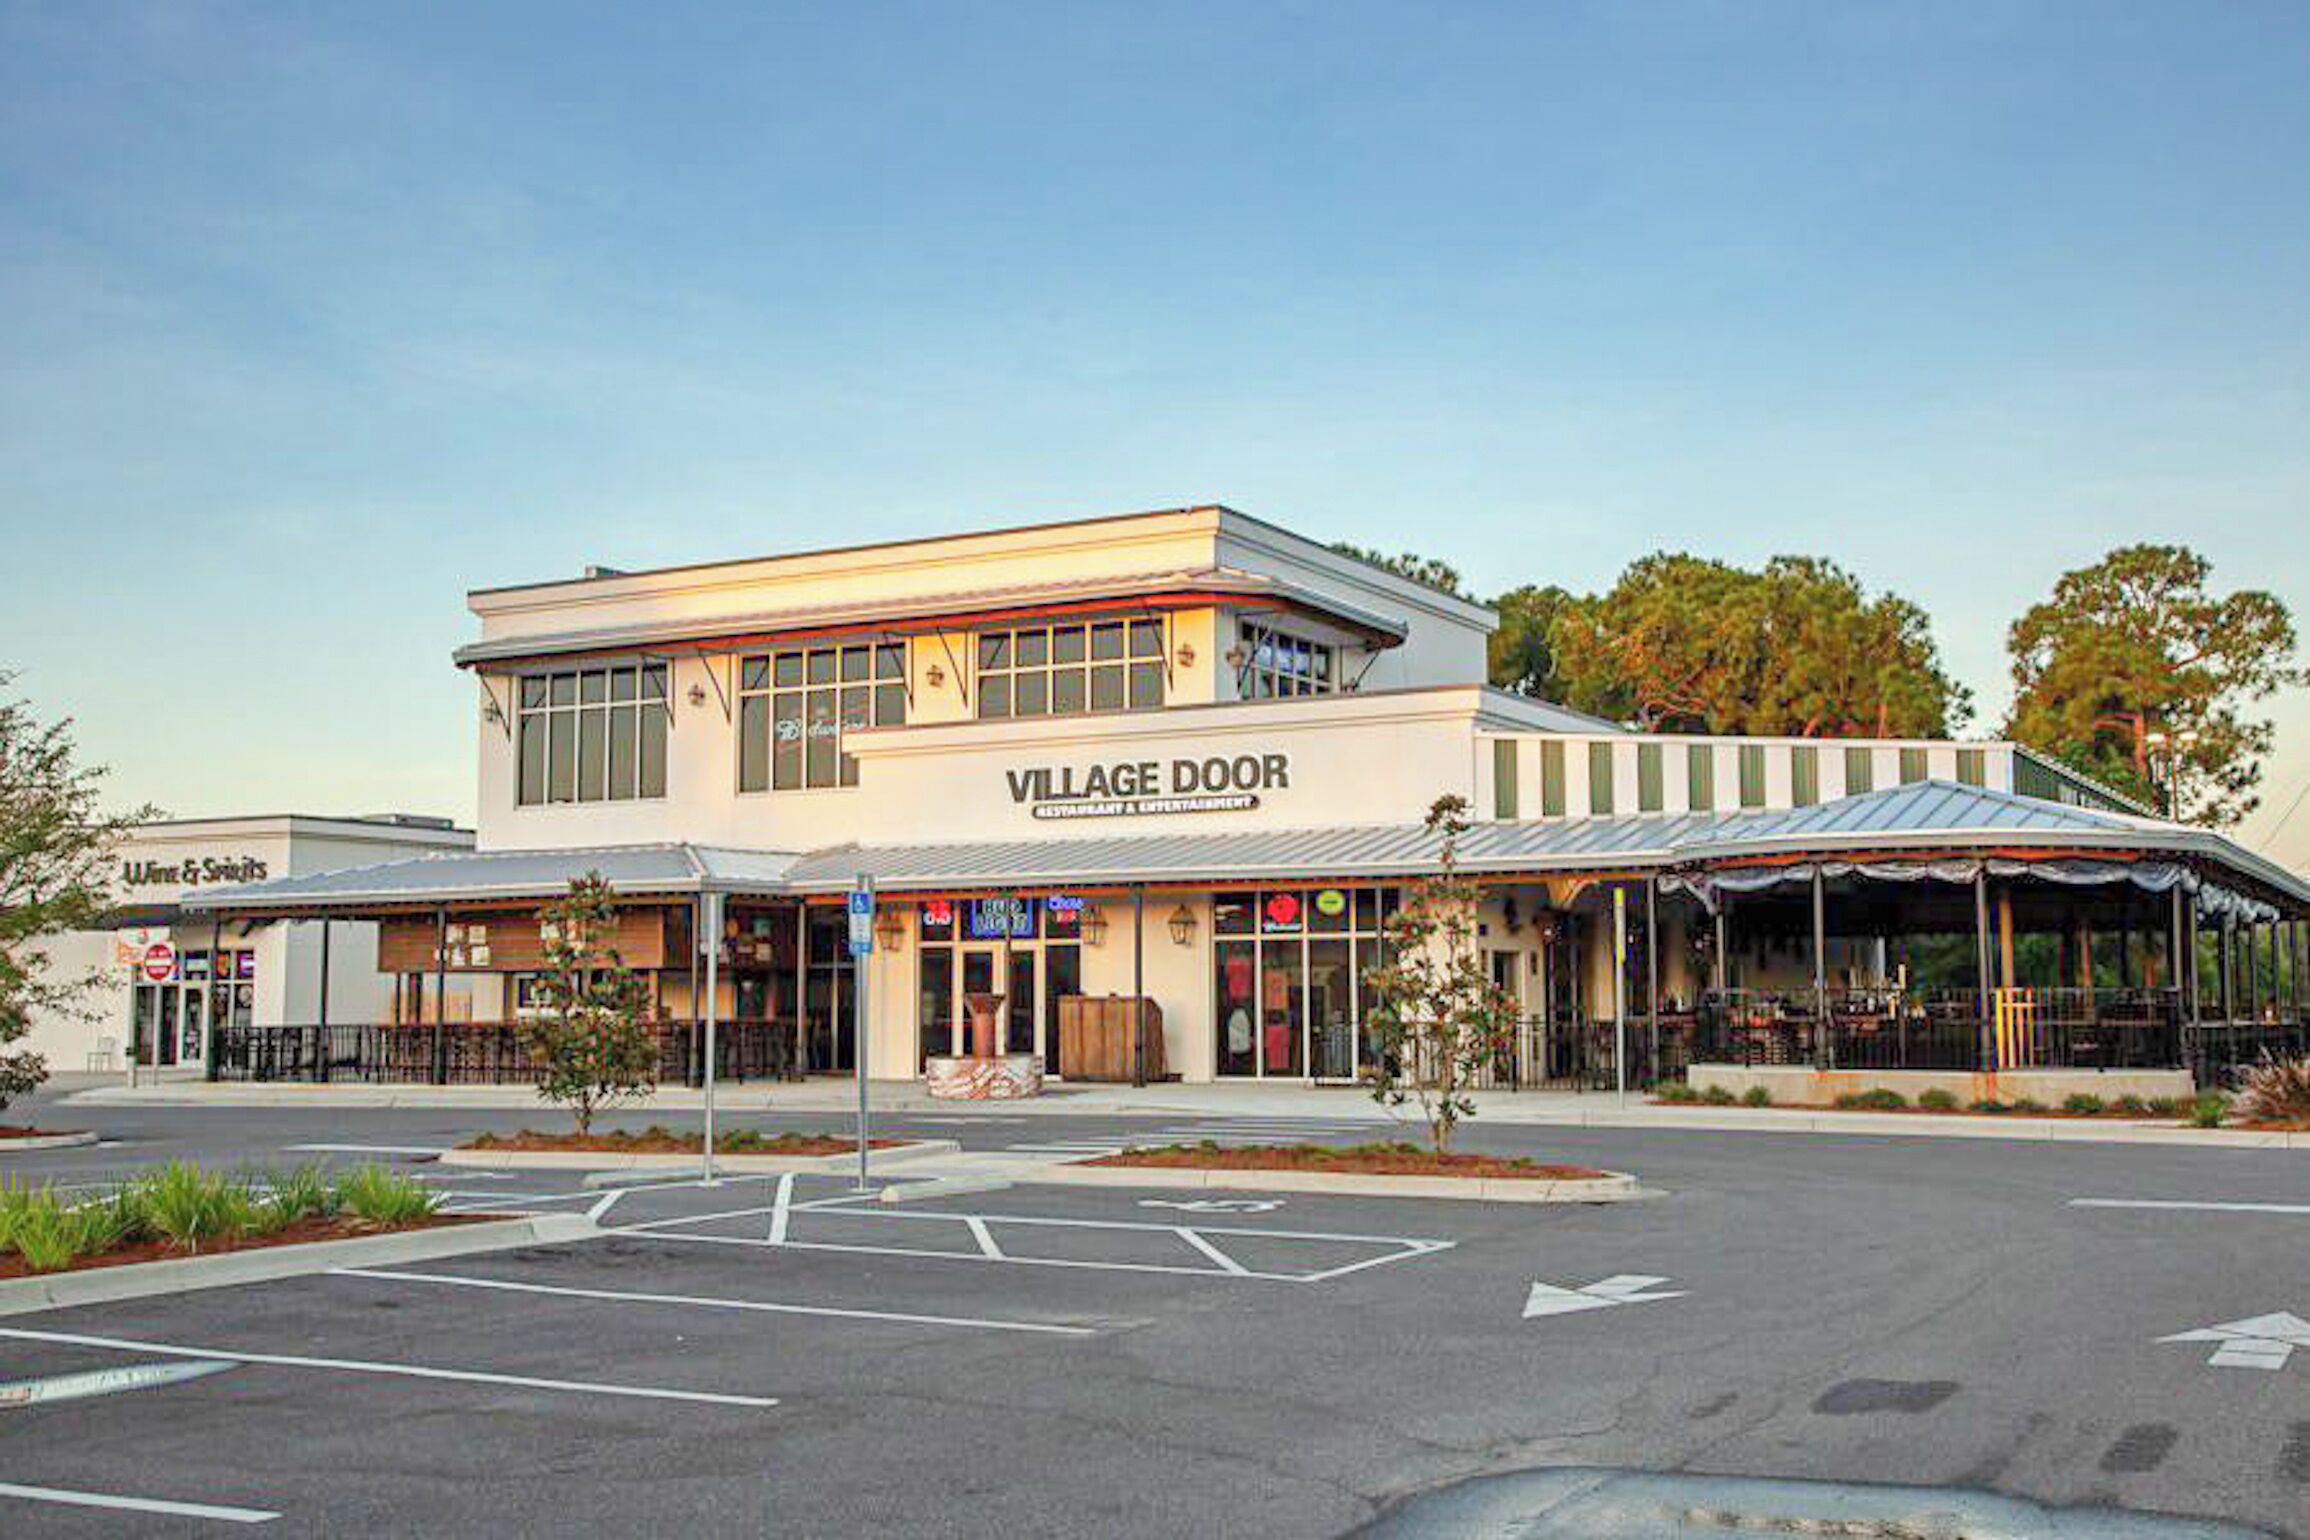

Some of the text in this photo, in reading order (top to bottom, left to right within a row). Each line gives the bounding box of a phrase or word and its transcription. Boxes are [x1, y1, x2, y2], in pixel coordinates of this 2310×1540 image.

[1006, 754, 1289, 802] VILLAGE DOOR
[1036, 803, 1124, 817] RESTAURANT
[1138, 795, 1252, 813] ENTERTAINMENT
[124, 855, 268, 885] Wine & Spirits
